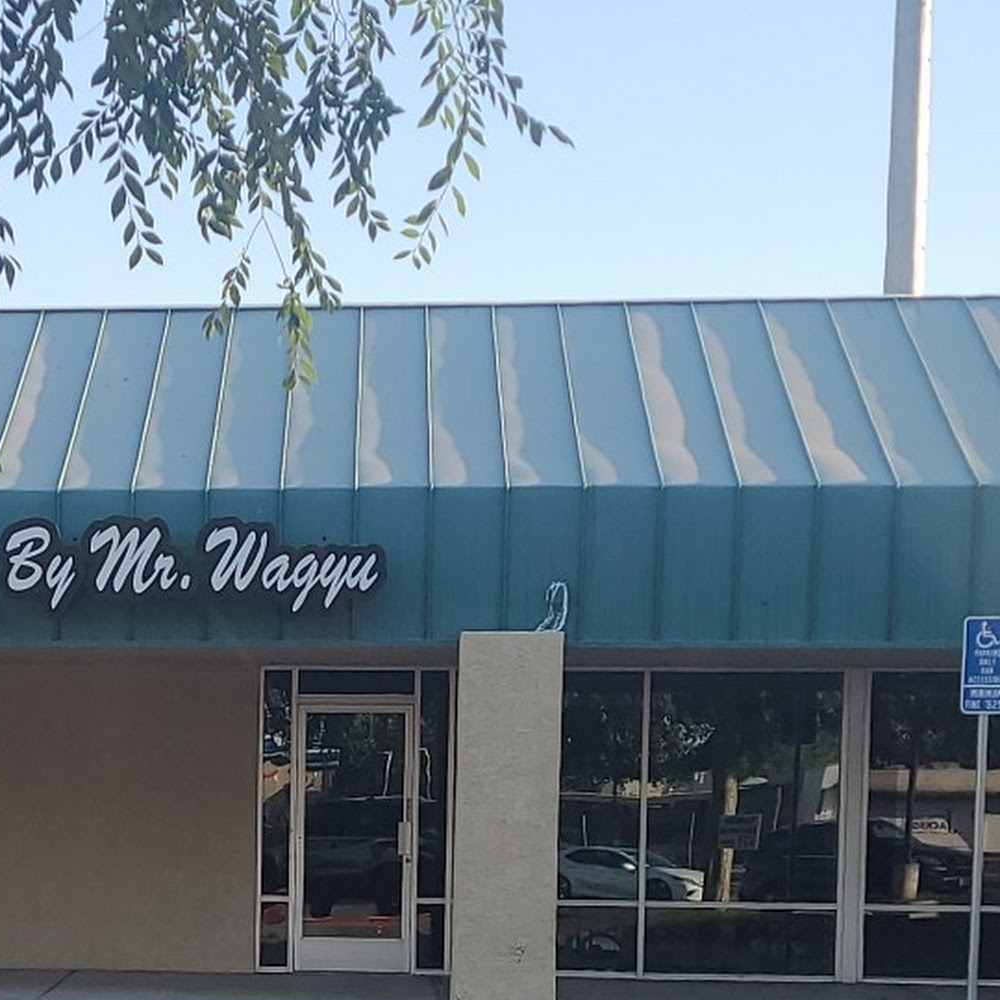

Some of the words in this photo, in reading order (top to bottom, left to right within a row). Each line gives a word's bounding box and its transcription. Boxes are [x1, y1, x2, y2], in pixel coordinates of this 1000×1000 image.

[5, 525, 76, 611] By
[88, 525, 191, 595] Mr.
[204, 525, 380, 612] Wagyu
